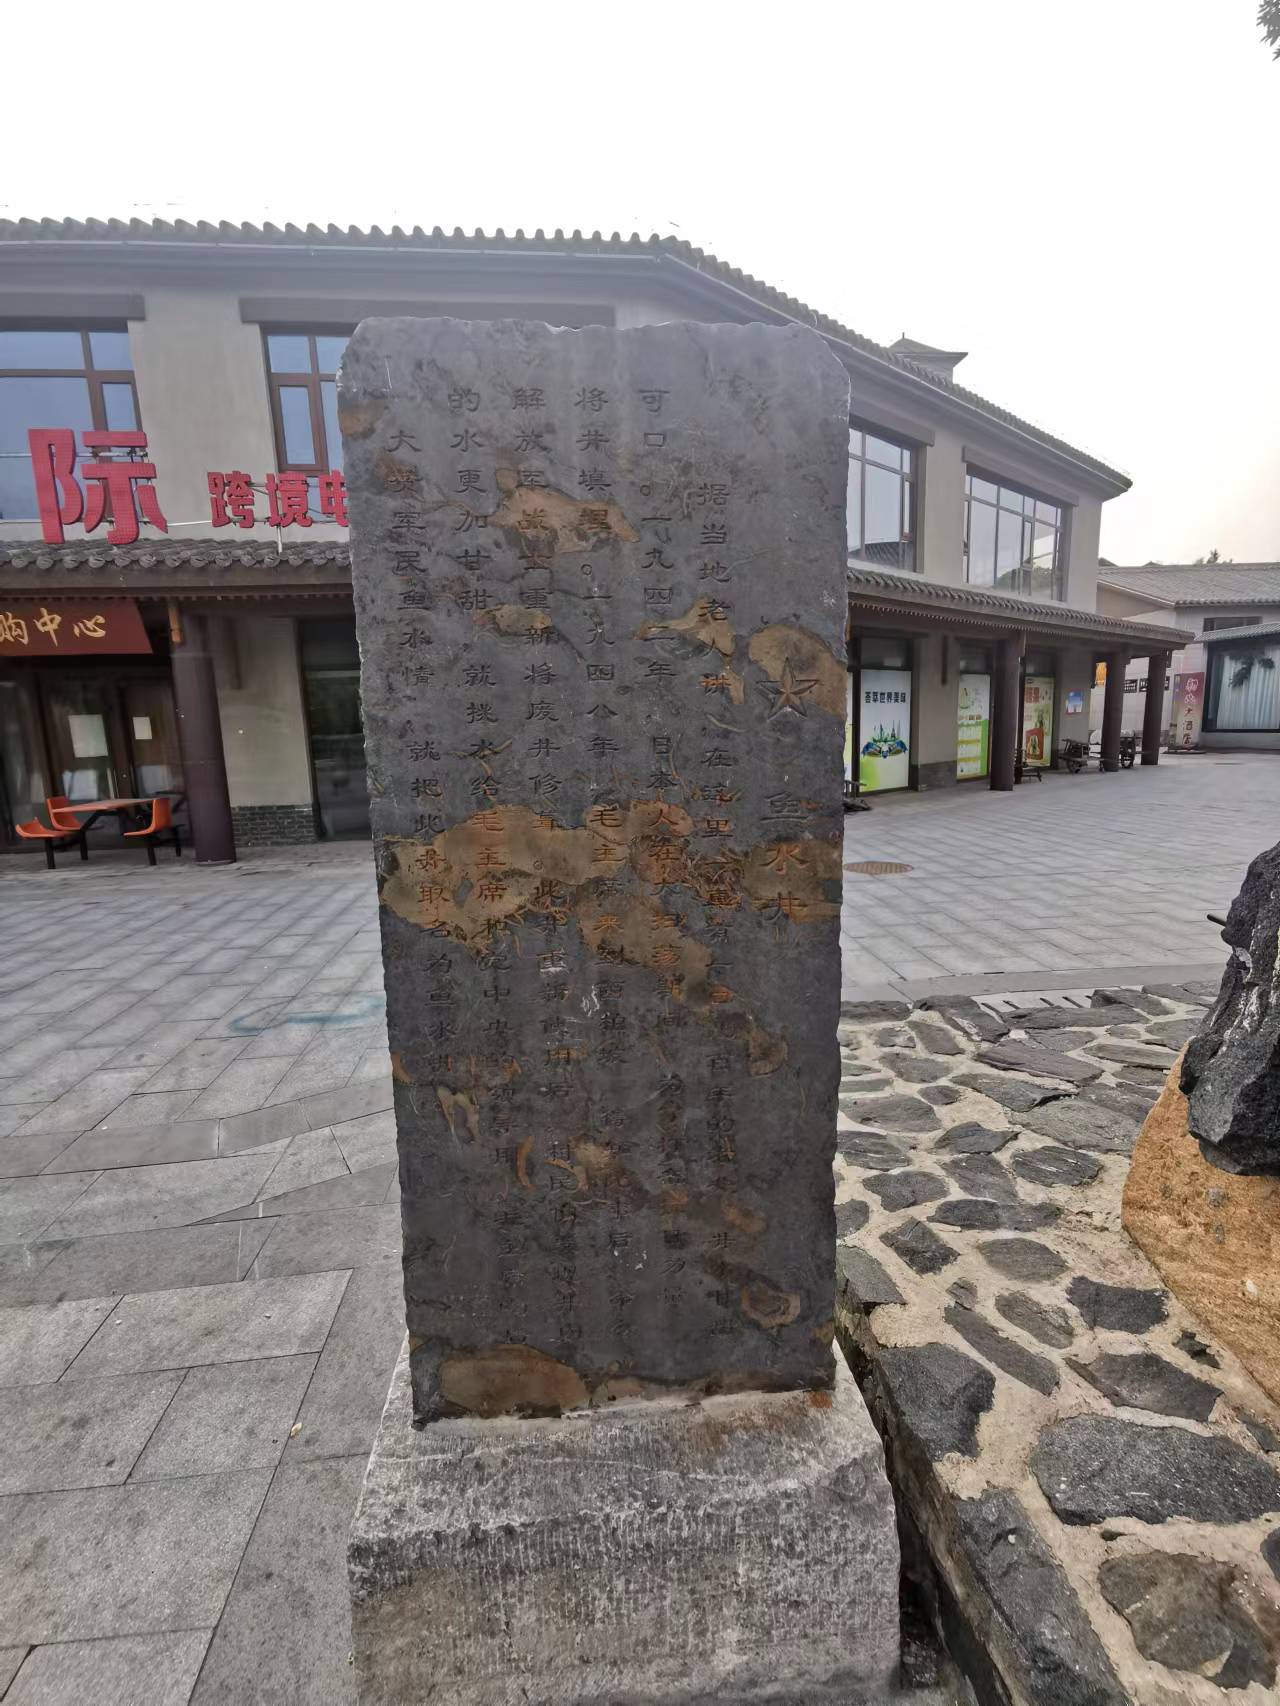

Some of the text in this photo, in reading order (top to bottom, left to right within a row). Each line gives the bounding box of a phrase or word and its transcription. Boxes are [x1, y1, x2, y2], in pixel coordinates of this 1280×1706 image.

[28, 429, 168, 544] 际
[759, 791, 810, 922] 鱼水井
